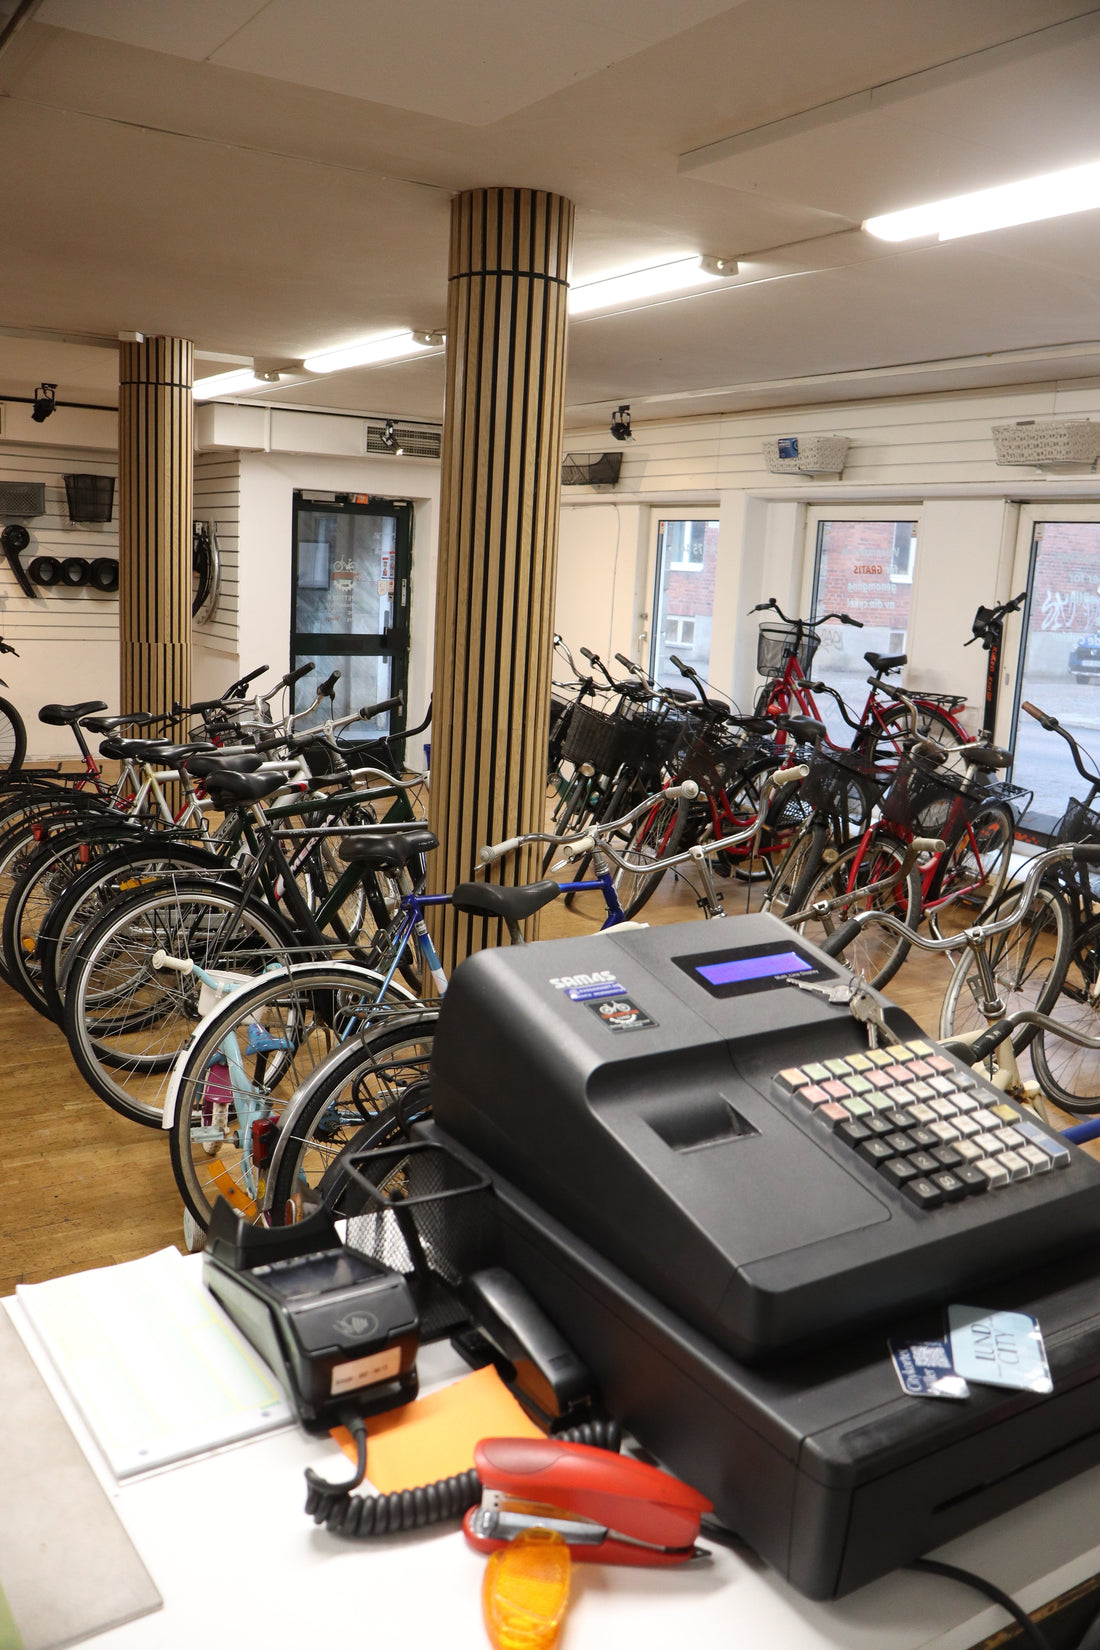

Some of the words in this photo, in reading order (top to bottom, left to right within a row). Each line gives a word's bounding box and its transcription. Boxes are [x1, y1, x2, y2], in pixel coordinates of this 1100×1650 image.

[917, 1156, 930, 1166] 2
[970, 1322, 996, 1363] LUND
[994, 1330, 1021, 1366] CITY
